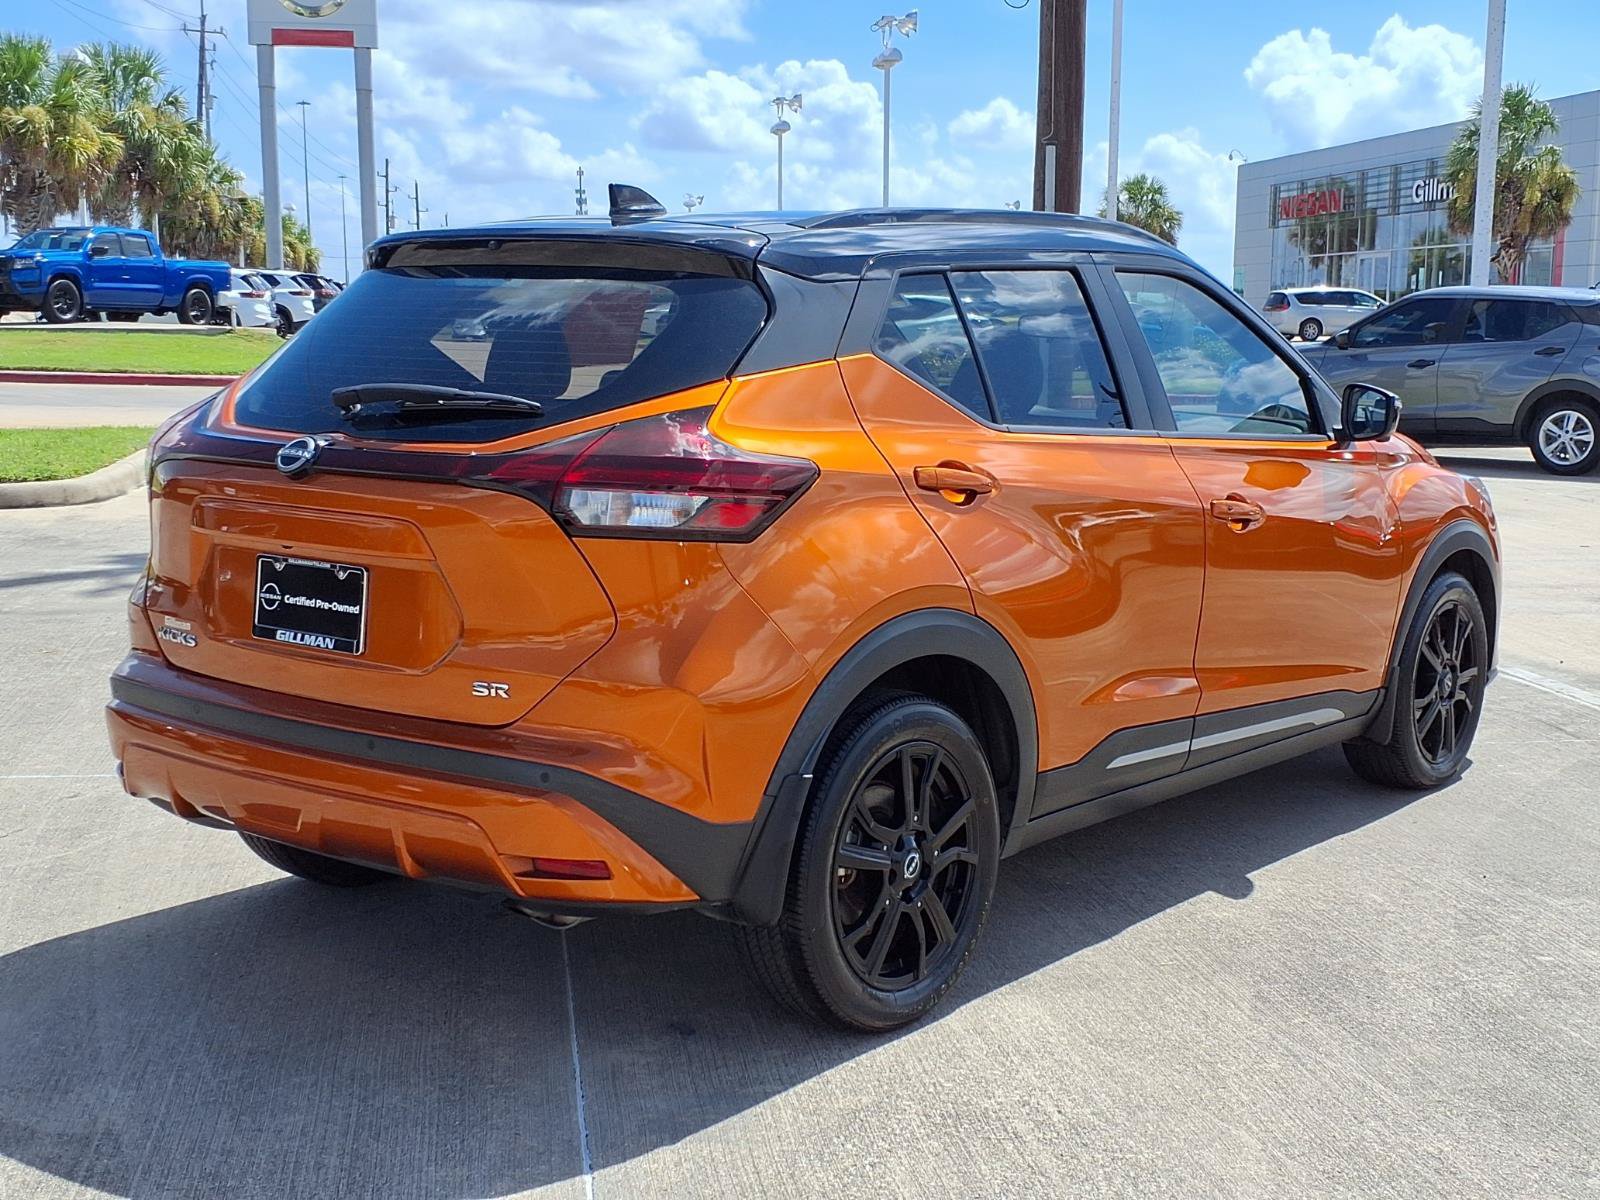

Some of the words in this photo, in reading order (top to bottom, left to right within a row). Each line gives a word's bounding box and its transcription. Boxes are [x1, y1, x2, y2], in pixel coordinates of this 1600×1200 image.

[1280, 188, 1345, 218] NISSAN
[284, 594, 316, 608] Certified
[316, 600, 360, 614] Pre-Owned
[158, 626, 198, 648] KICKS
[275, 629, 336, 650] GILLMAN
[471, 681, 511, 699] SR
